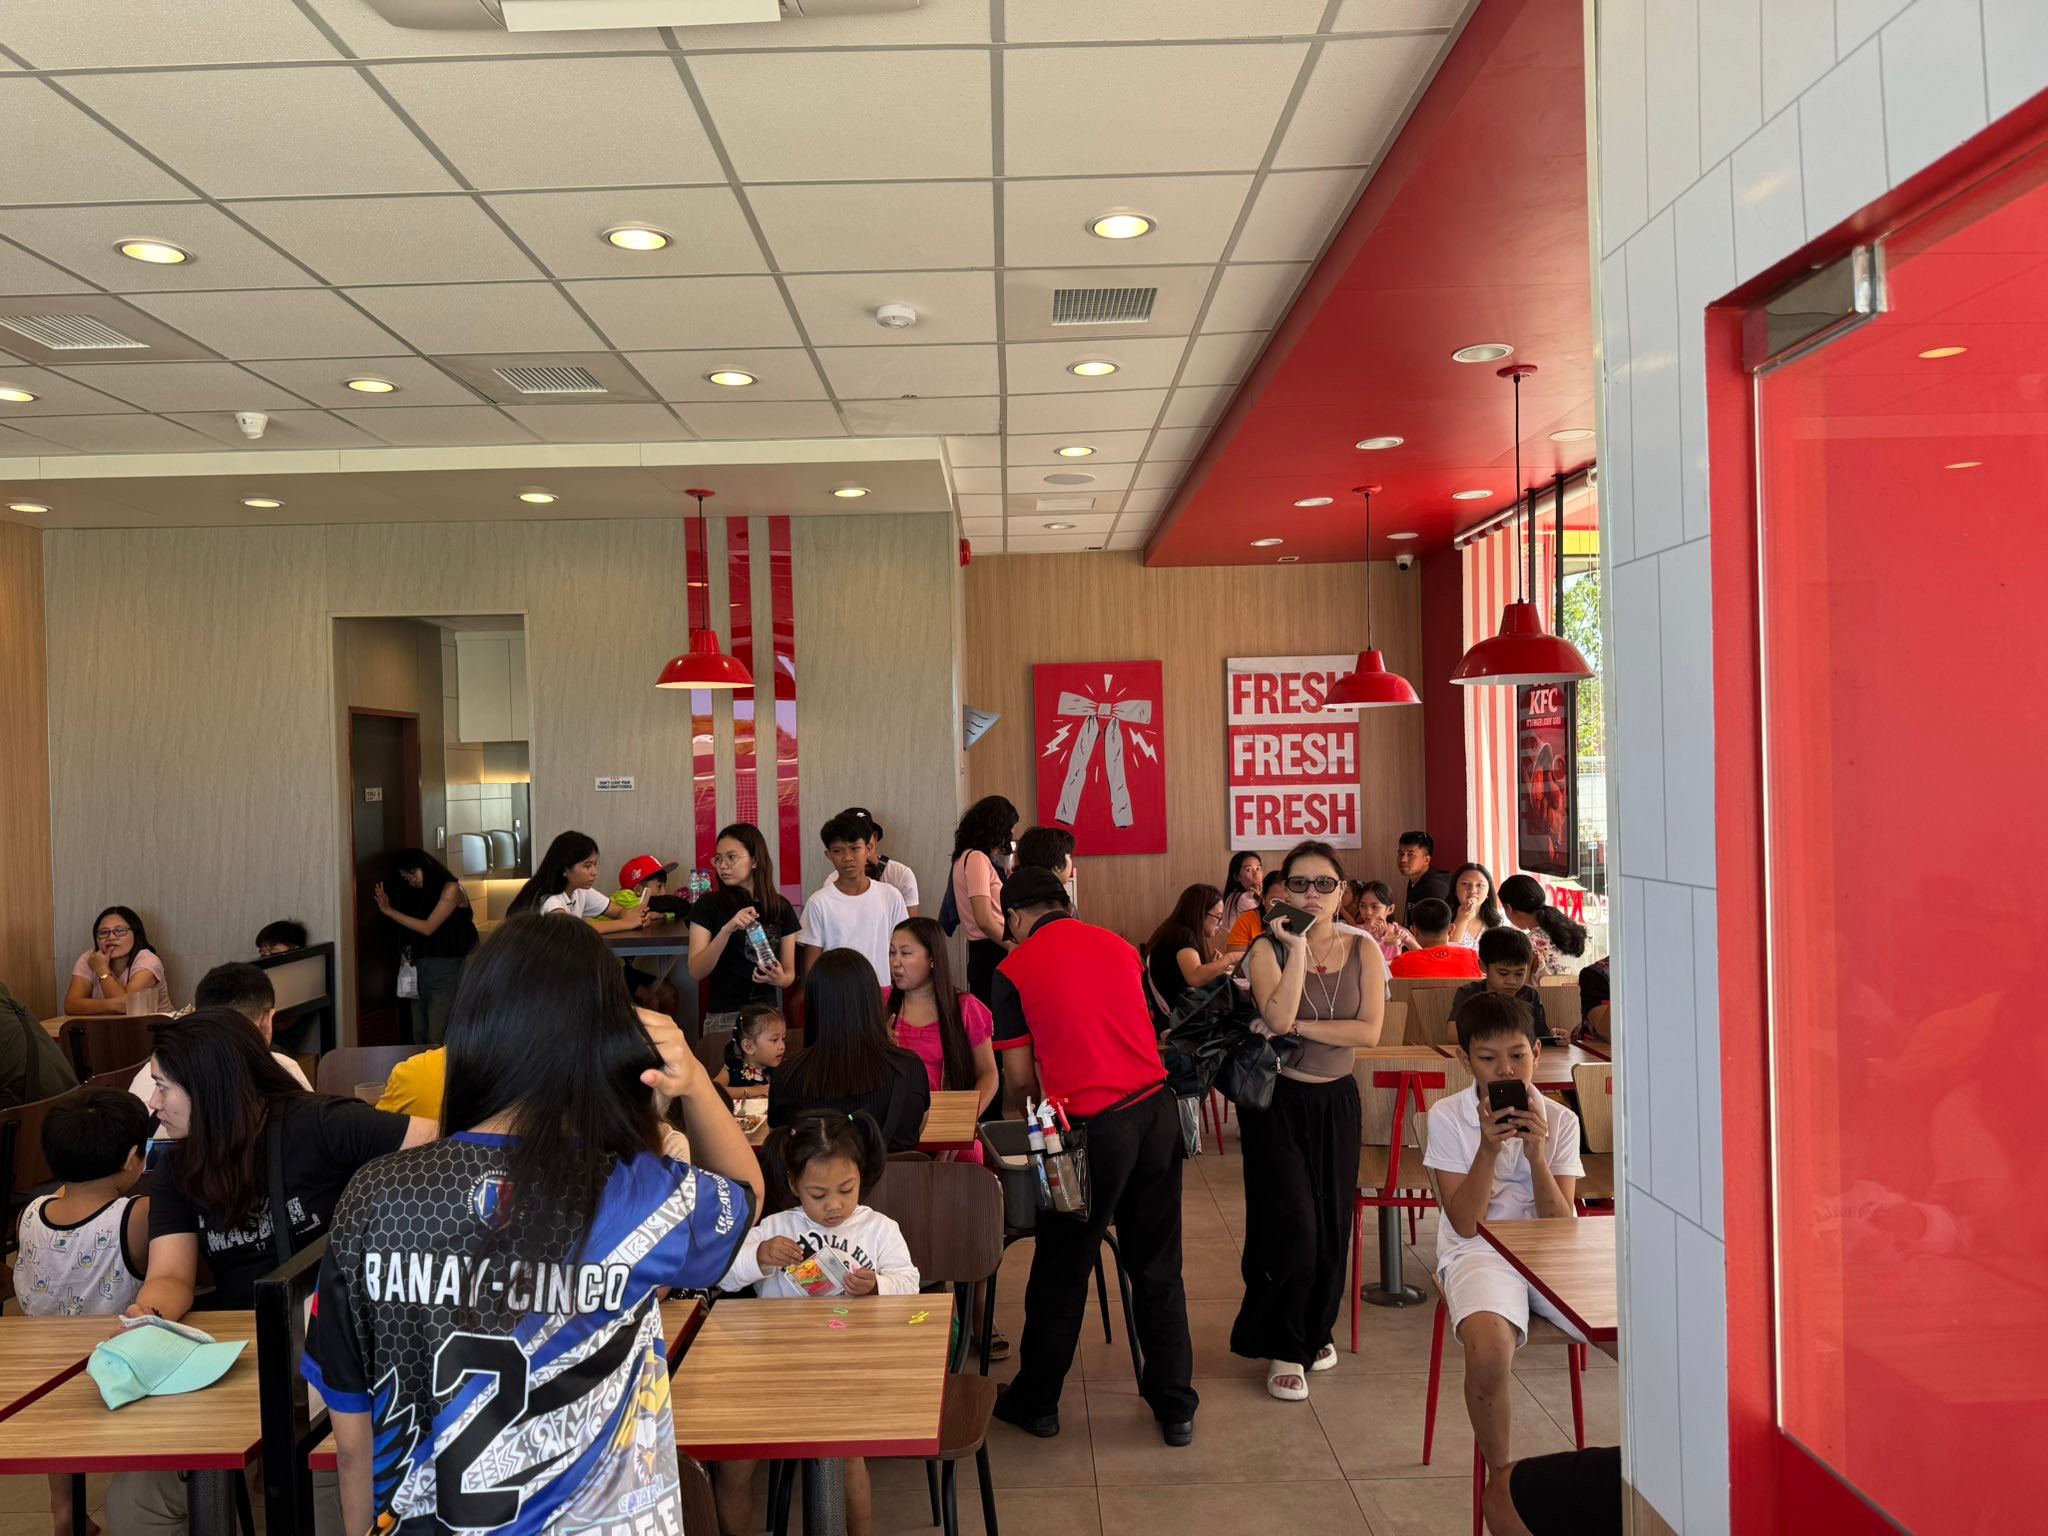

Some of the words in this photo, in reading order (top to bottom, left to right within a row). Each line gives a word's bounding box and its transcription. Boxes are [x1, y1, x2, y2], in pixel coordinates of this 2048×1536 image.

[1529, 687, 1558, 714] KFC
[1233, 732, 1355, 777] FRESH
[1234, 793, 1356, 836] FRESH
[852, 1246, 876, 1272] KID
[365, 1253, 630, 1314] BANAY-CINCO
[433, 1331, 531, 1531] 2
